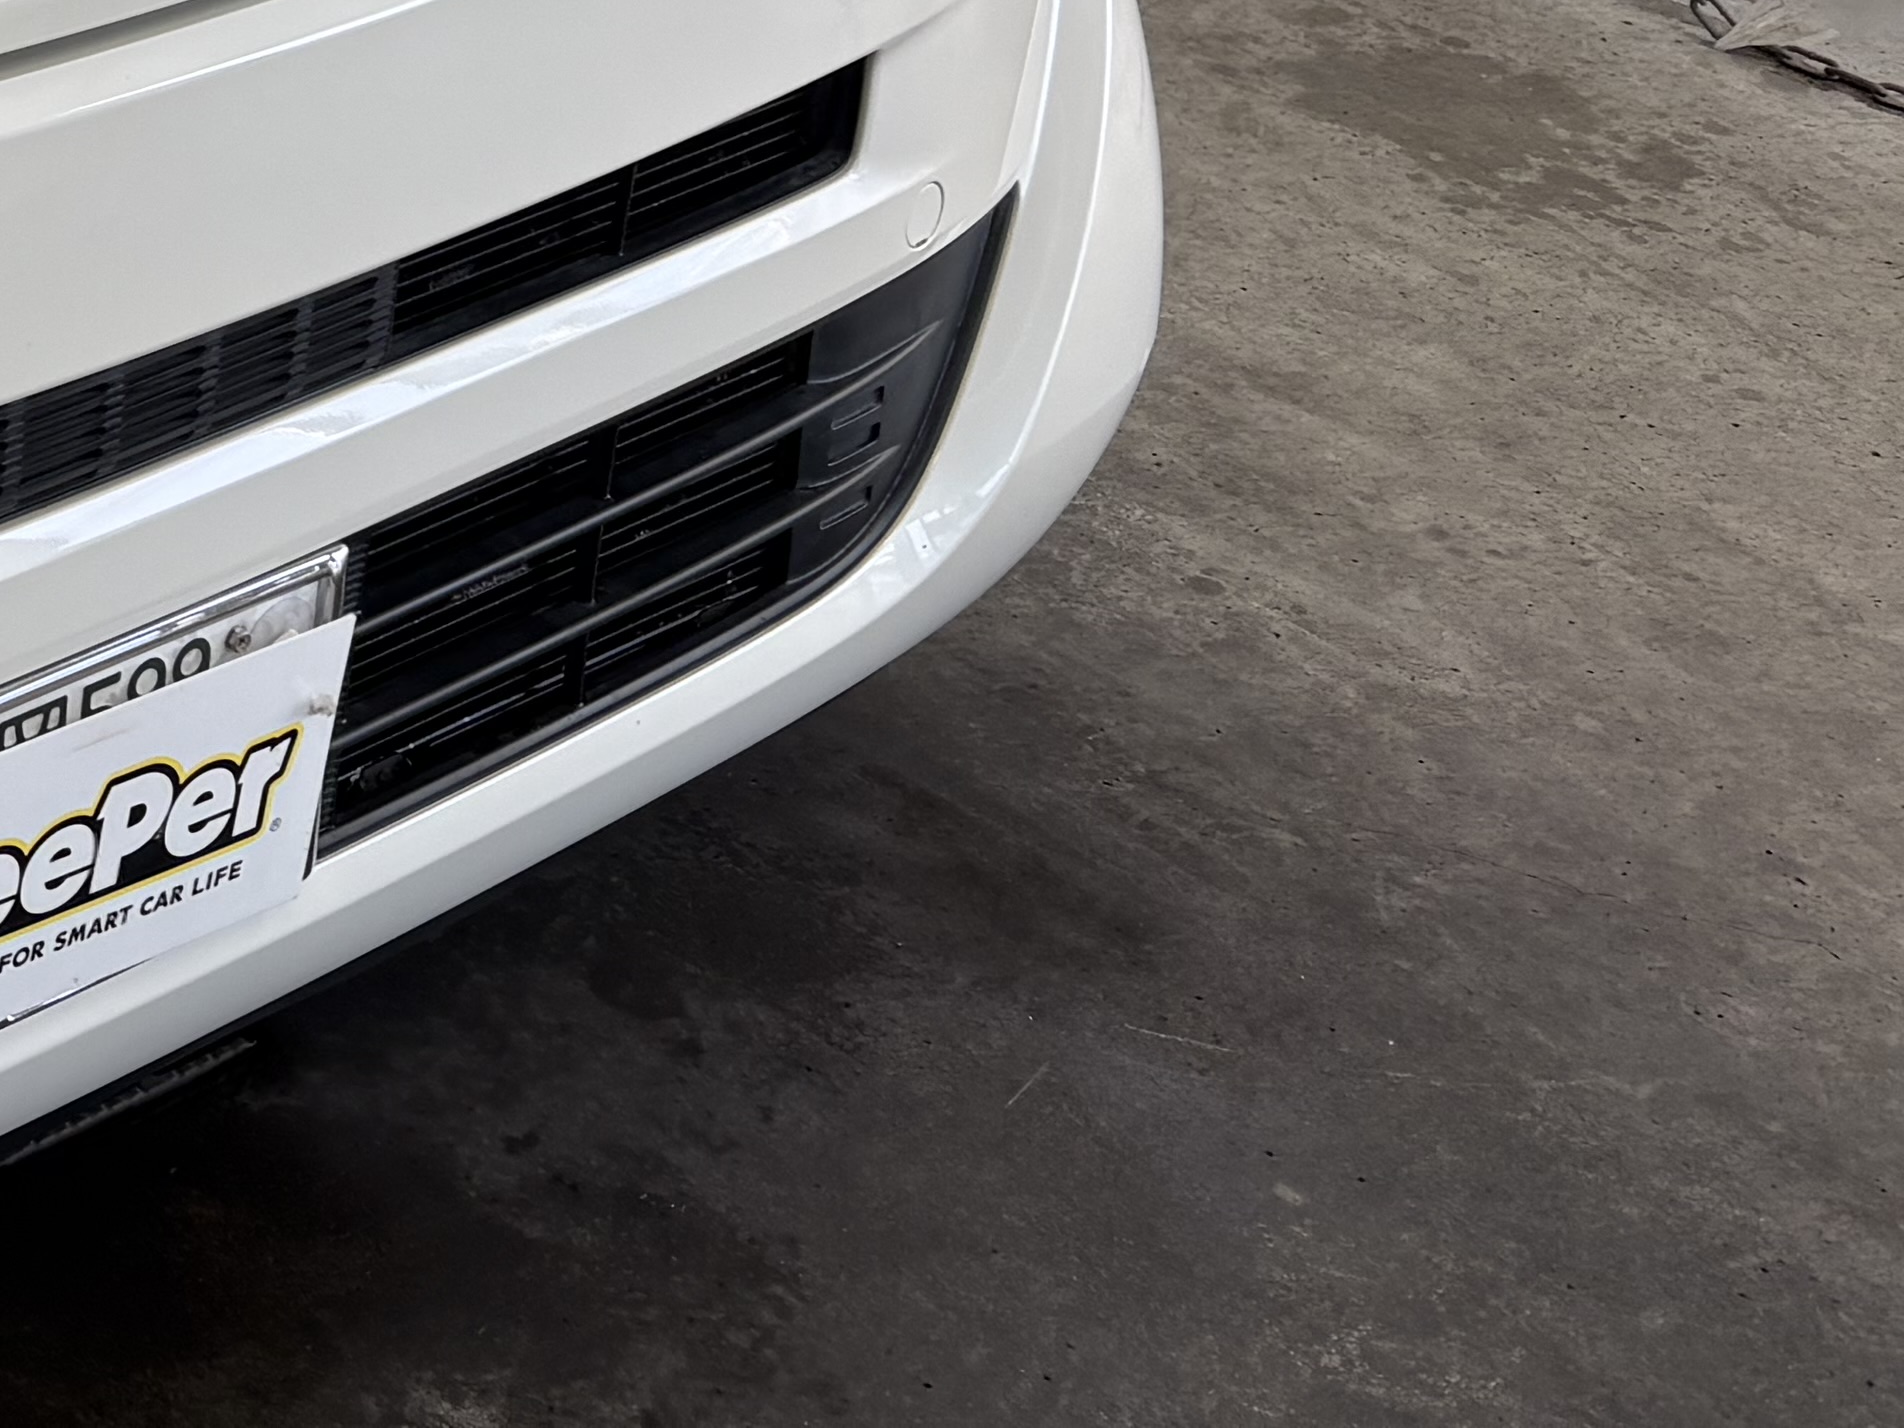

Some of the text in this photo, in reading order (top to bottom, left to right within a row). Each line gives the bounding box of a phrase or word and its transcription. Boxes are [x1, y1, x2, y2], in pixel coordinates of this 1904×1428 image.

[53, 905, 133, 952] SMART
[140, 885, 183, 916] CAR
[191, 859, 243, 896] LIFE
